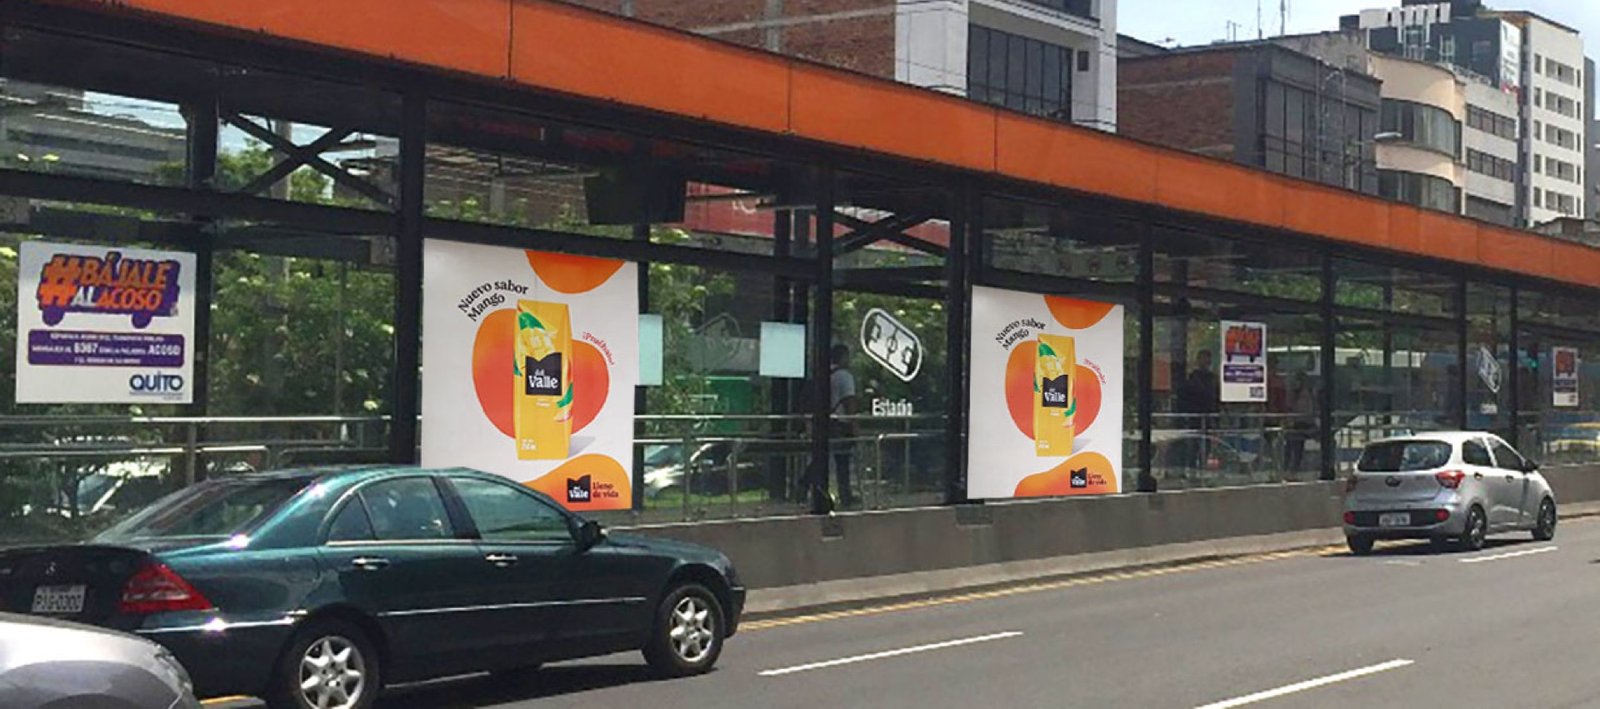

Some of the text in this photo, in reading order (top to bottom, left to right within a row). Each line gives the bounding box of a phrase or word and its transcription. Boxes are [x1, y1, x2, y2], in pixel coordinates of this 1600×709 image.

[458, 280, 529, 313] Nuevo sabor
[467, 293, 505, 322] Mango
[528, 375, 558, 389] Valle
[872, 397, 913, 417] Estadio
